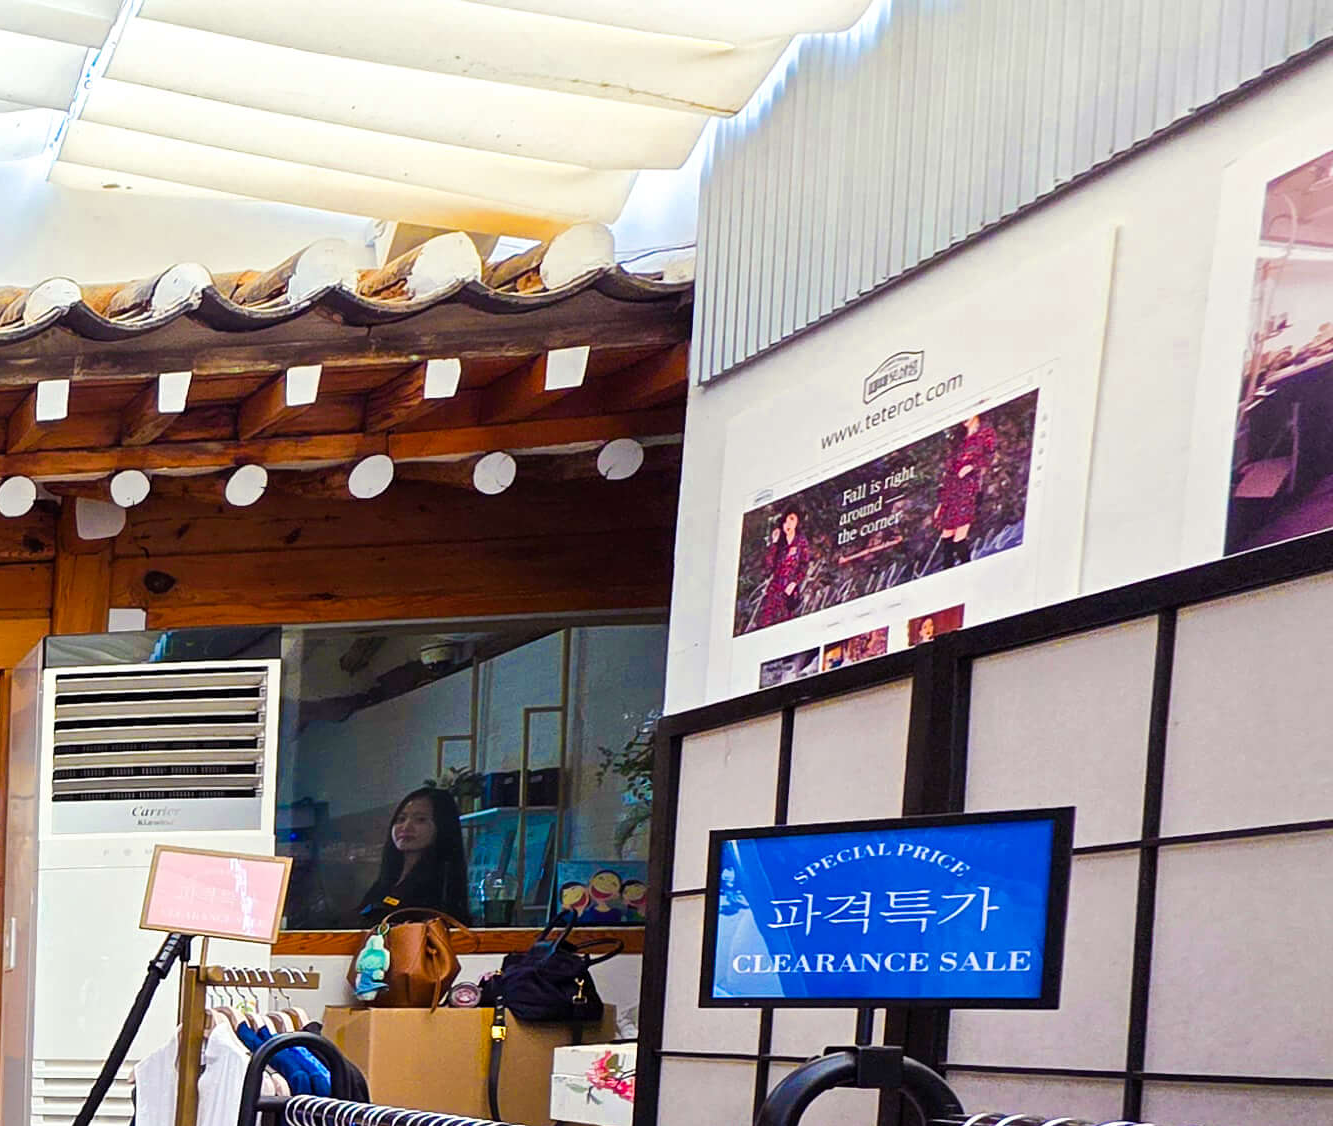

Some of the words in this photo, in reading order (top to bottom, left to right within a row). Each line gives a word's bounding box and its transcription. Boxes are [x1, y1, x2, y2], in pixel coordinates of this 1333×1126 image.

[821, 374, 963, 449] www.teterot.com
[842, 483, 866, 506] Fall
[870, 480, 882, 494] is
[884, 466, 917, 489] right
[838, 528, 857, 544] the
[860, 511, 903, 536] corner
[839, 496, 883, 526] around
[132, 806, 181, 817] Carrier
[793, 843, 892, 885] SPECIAL
[897, 843, 971, 878] PRICE
[766, 886, 1000, 936] 파격특가
[732, 952, 930, 974] CLEARANCE
[939, 951, 1031, 973] SALE
